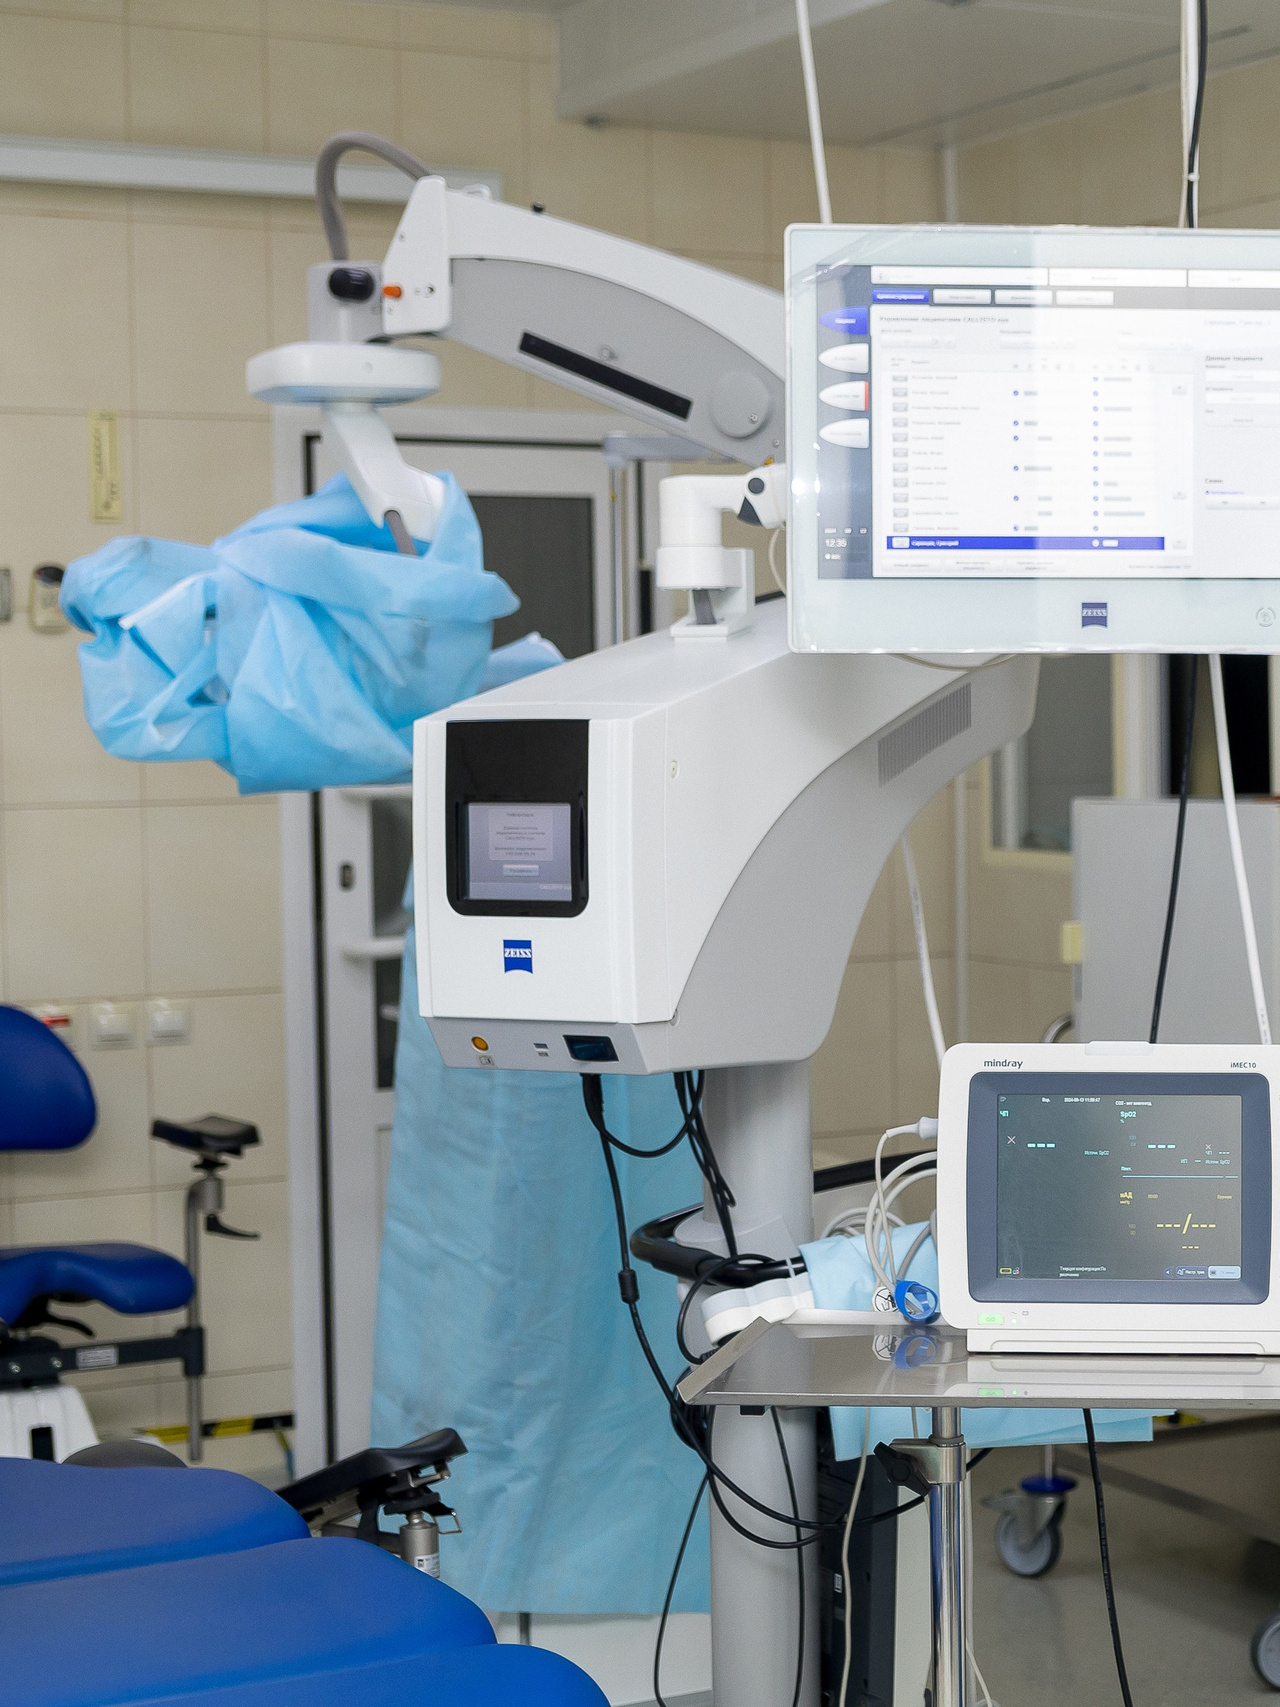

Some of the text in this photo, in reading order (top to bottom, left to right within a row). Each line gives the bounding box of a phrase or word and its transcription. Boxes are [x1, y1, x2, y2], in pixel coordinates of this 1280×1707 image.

[504, 948, 532, 958] ZEISS
[984, 1059, 1024, 1069] mindray
[1120, 1110, 1137, 1119] SpO2
